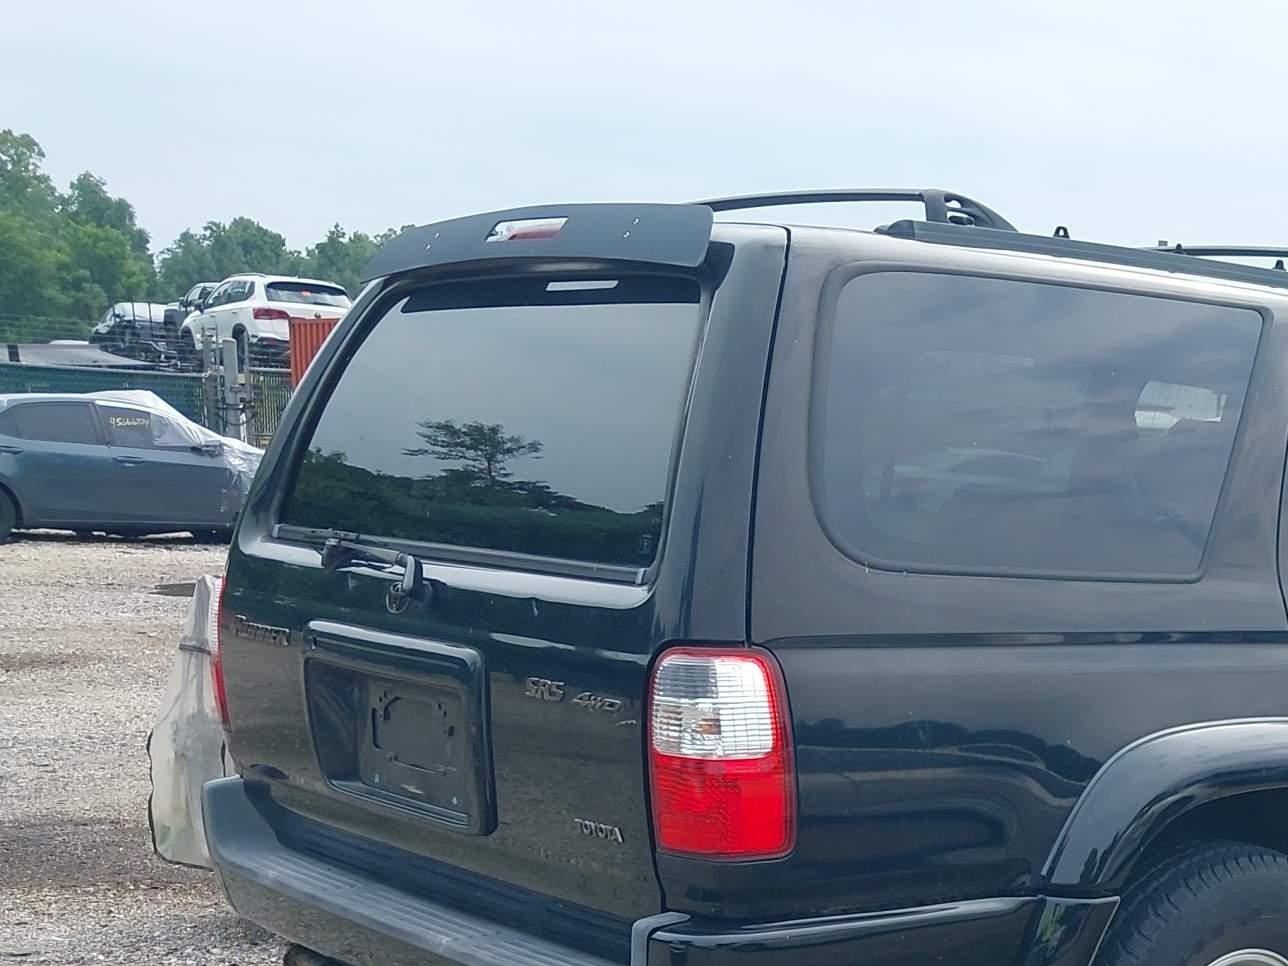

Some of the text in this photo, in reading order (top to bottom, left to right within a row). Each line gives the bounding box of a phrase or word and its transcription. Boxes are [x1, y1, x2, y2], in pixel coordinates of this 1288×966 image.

[524, 676, 624, 711] SR5 4WD
[573, 817, 624, 843] TOYOTA
